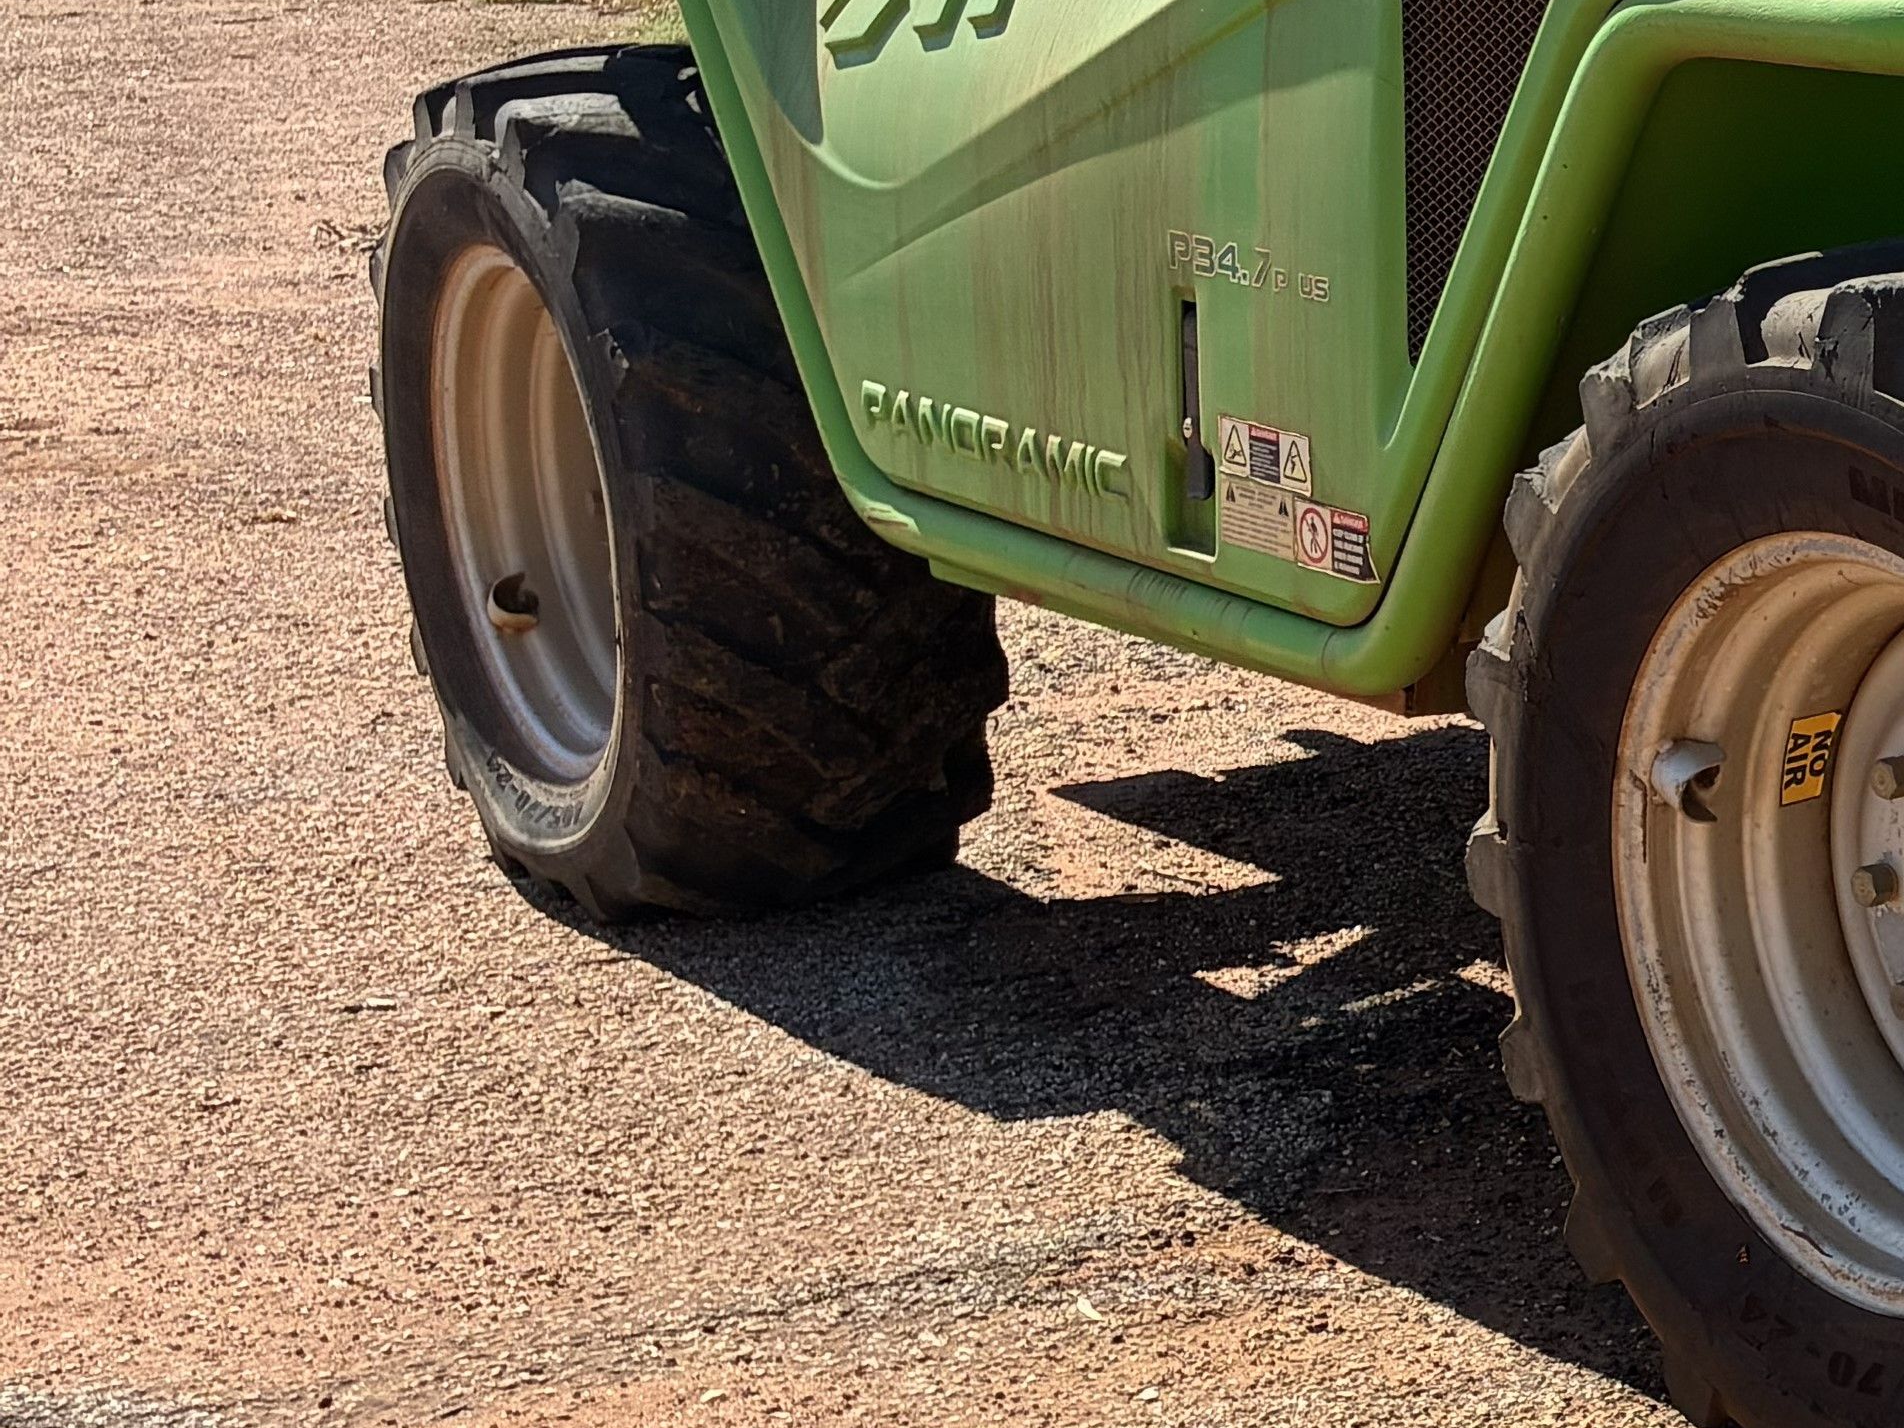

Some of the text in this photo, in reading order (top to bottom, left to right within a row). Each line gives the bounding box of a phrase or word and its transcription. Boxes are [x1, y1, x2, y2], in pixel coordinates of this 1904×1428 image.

[861, 379, 1130, 503] PANORAMIC
[1783, 732, 1813, 791] AIR
[1808, 729, 1833, 777] NO
